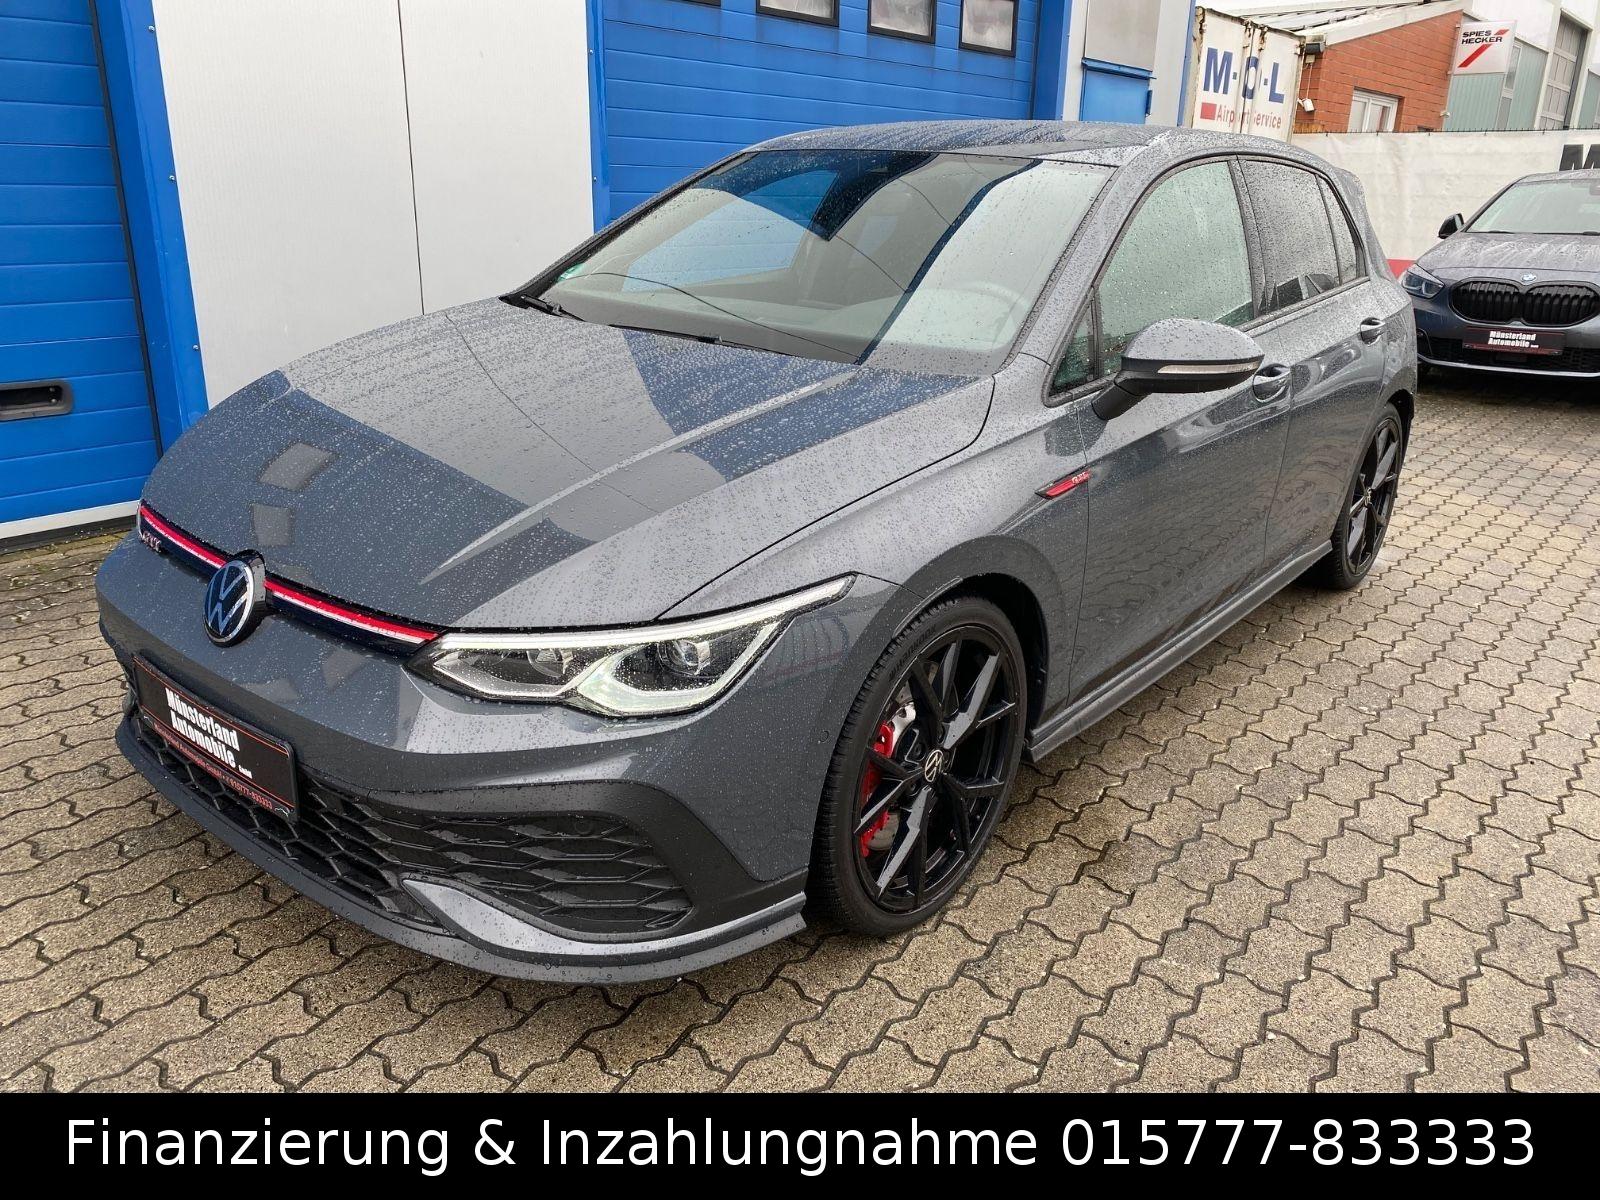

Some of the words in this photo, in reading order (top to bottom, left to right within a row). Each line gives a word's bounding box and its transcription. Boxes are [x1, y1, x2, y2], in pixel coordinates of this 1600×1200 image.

[1462, 30, 1492, 38] SPIES
[1461, 36, 1503, 44] HECKER
[1487, 337, 1530, 348] Automobile
[165, 687, 240, 752] Münsterland
[170, 709, 236, 769] Automobile
